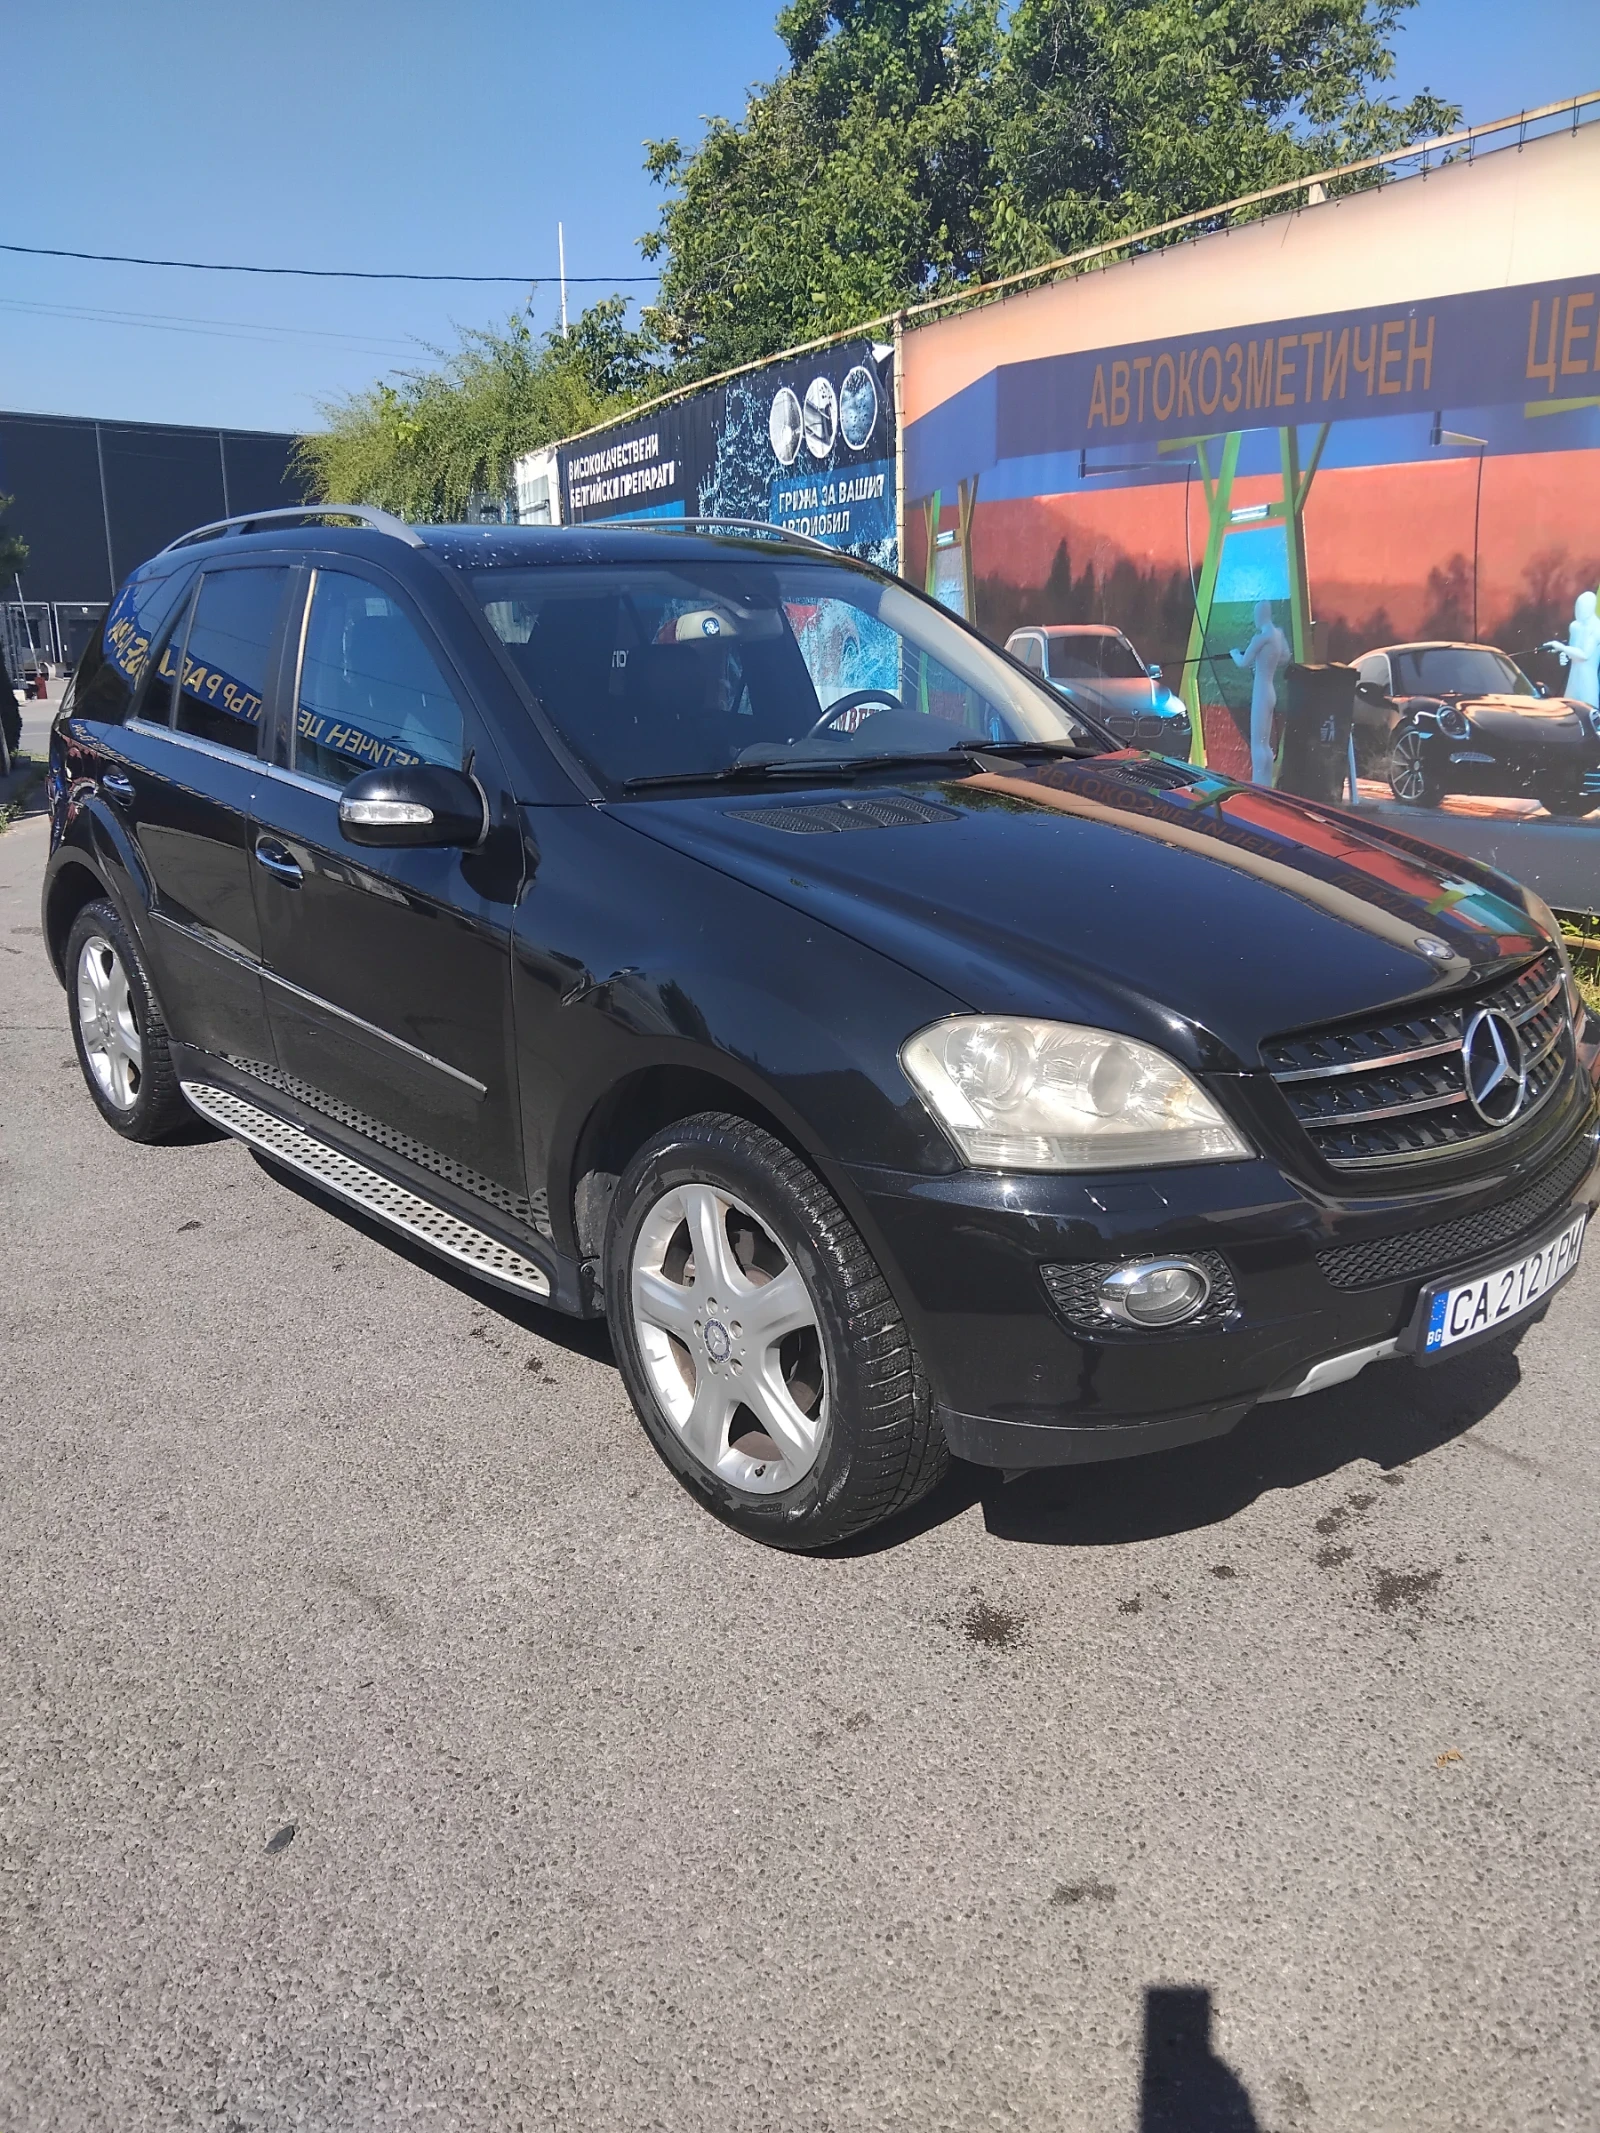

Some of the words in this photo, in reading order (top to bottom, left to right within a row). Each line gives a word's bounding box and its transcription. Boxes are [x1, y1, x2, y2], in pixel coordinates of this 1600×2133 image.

[1087, 315, 1436, 430] АВТОКОЗМЕТИЧЕН
[1526, 291, 1600, 394] ЦЕ
[568, 433, 659, 481] ВИСОКОКАЧЕСТВЕНИ
[570, 476, 619, 508] БЕЛГИЙСКИ
[779, 487, 818, 513] ГРИЖА
[822, 483, 837, 506] ЗА
[838, 474, 885, 504] ВАШИЯ
[1450, 1281, 1489, 1337] CA
[1494, 1243, 1556, 1319] 2121
[1427, 1328, 1442, 1346] BG
